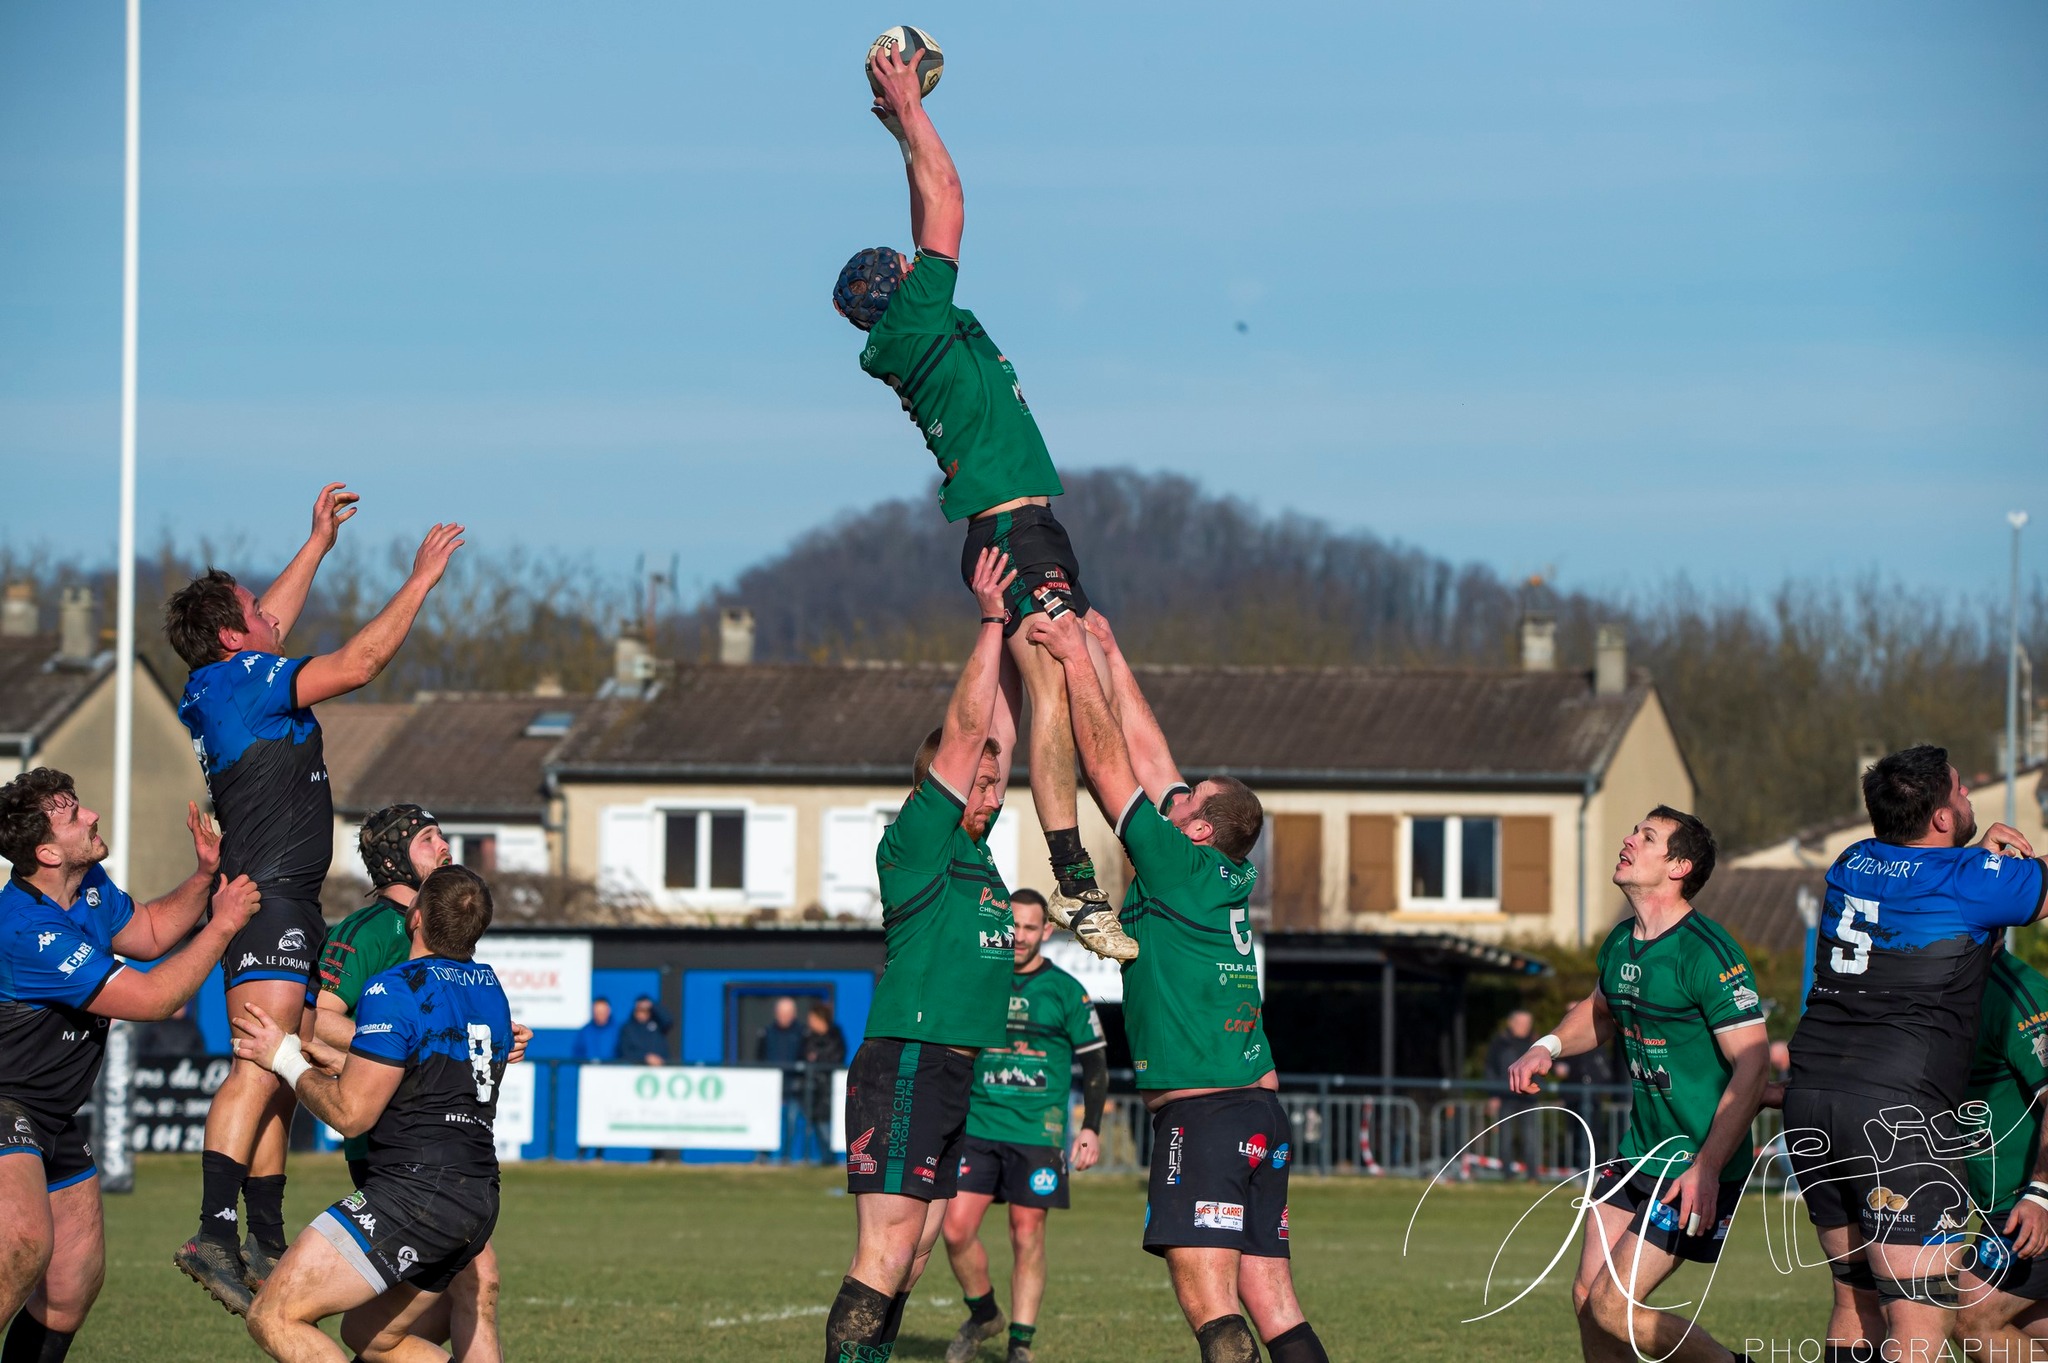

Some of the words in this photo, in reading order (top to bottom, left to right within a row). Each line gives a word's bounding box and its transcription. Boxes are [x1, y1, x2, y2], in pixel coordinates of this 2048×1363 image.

[1830, 893, 1880, 975] 5
[266, 955, 276, 965] LE
[1216, 962, 1244, 972] TOUR
[467, 1022, 495, 1103] 8
[893, 1078, 907, 1111] CLUB
[906, 1079, 914, 1096] PIN
[904, 1098, 913, 1114] DU
[888, 1114, 902, 1157] RUGBY
[901, 1115, 910, 1142] TOUR
[899, 1144, 907, 1158] LA
[860, 1163, 874, 1171] MOTO
